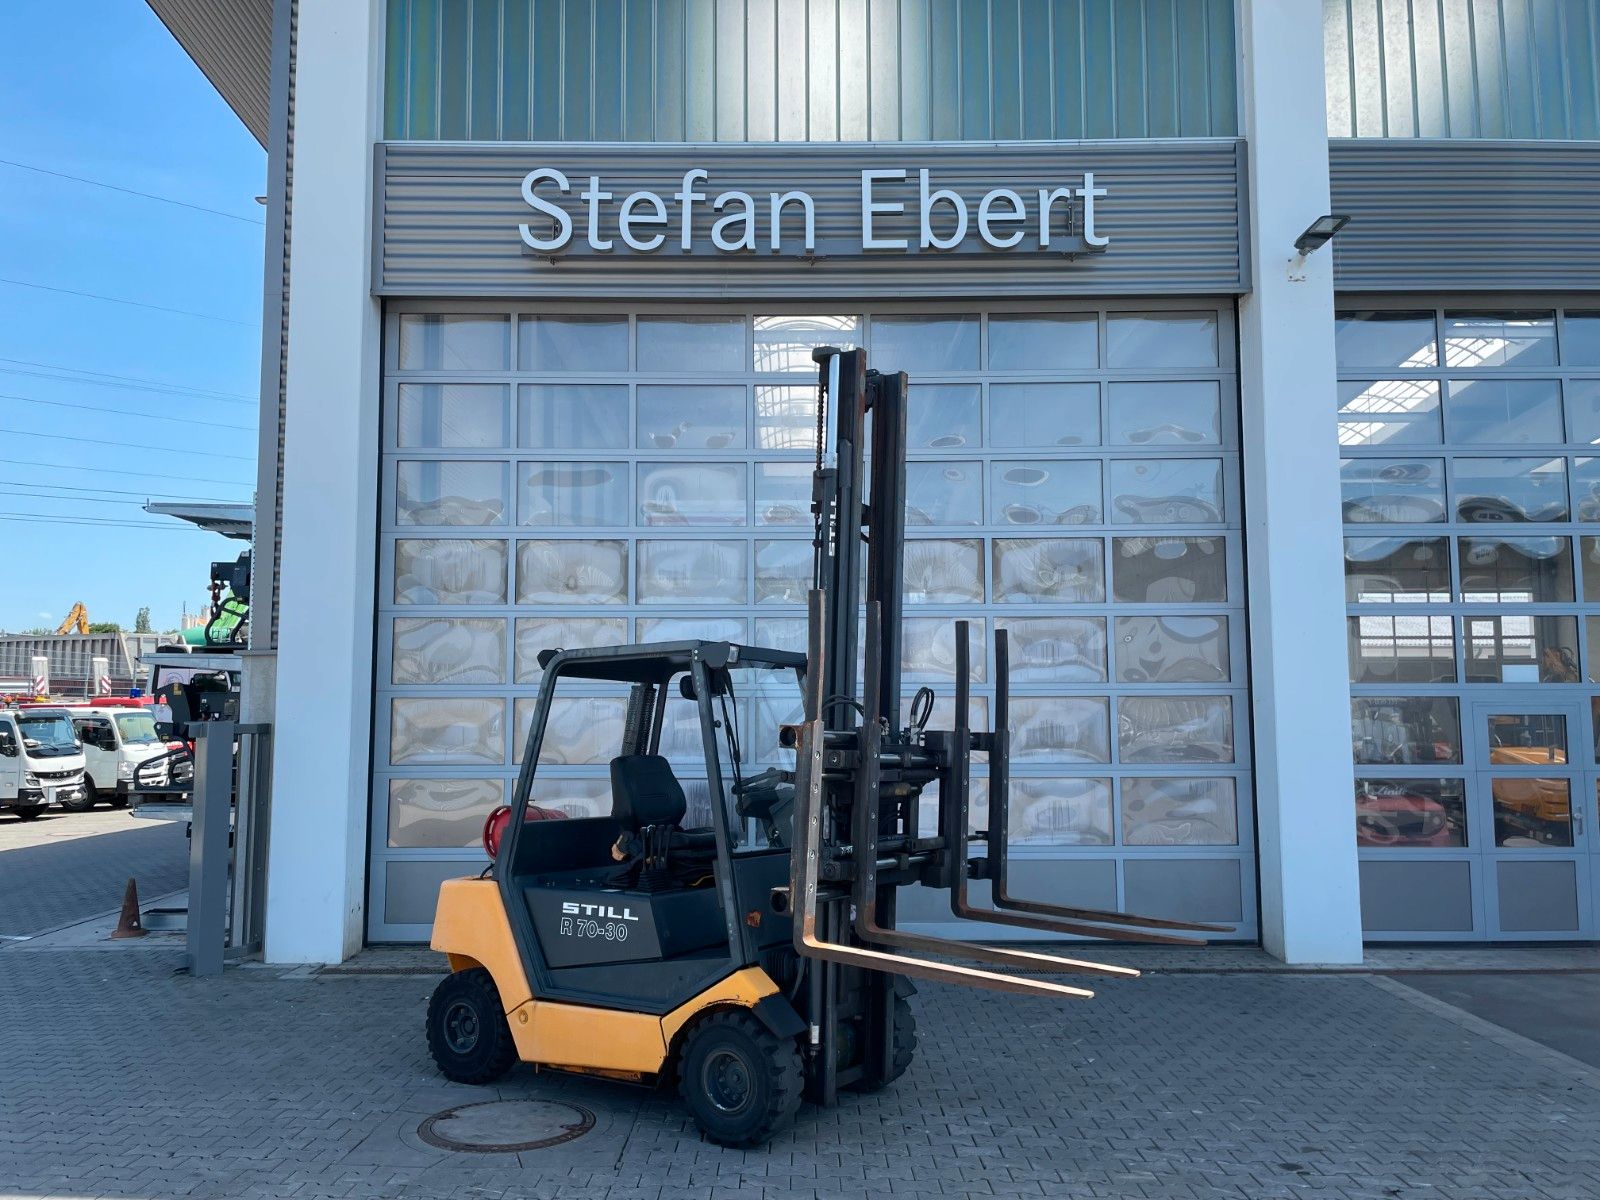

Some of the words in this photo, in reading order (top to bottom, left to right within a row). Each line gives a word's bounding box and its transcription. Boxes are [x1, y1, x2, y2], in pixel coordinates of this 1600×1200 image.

[518, 167, 816, 253] Stefan
[861, 167, 1110, 253] Ebert
[828, 494, 837, 557] STILL
[560, 916, 573, 936] R
[577, 918, 628, 942] 70-30
[562, 901, 639, 921] STILL
